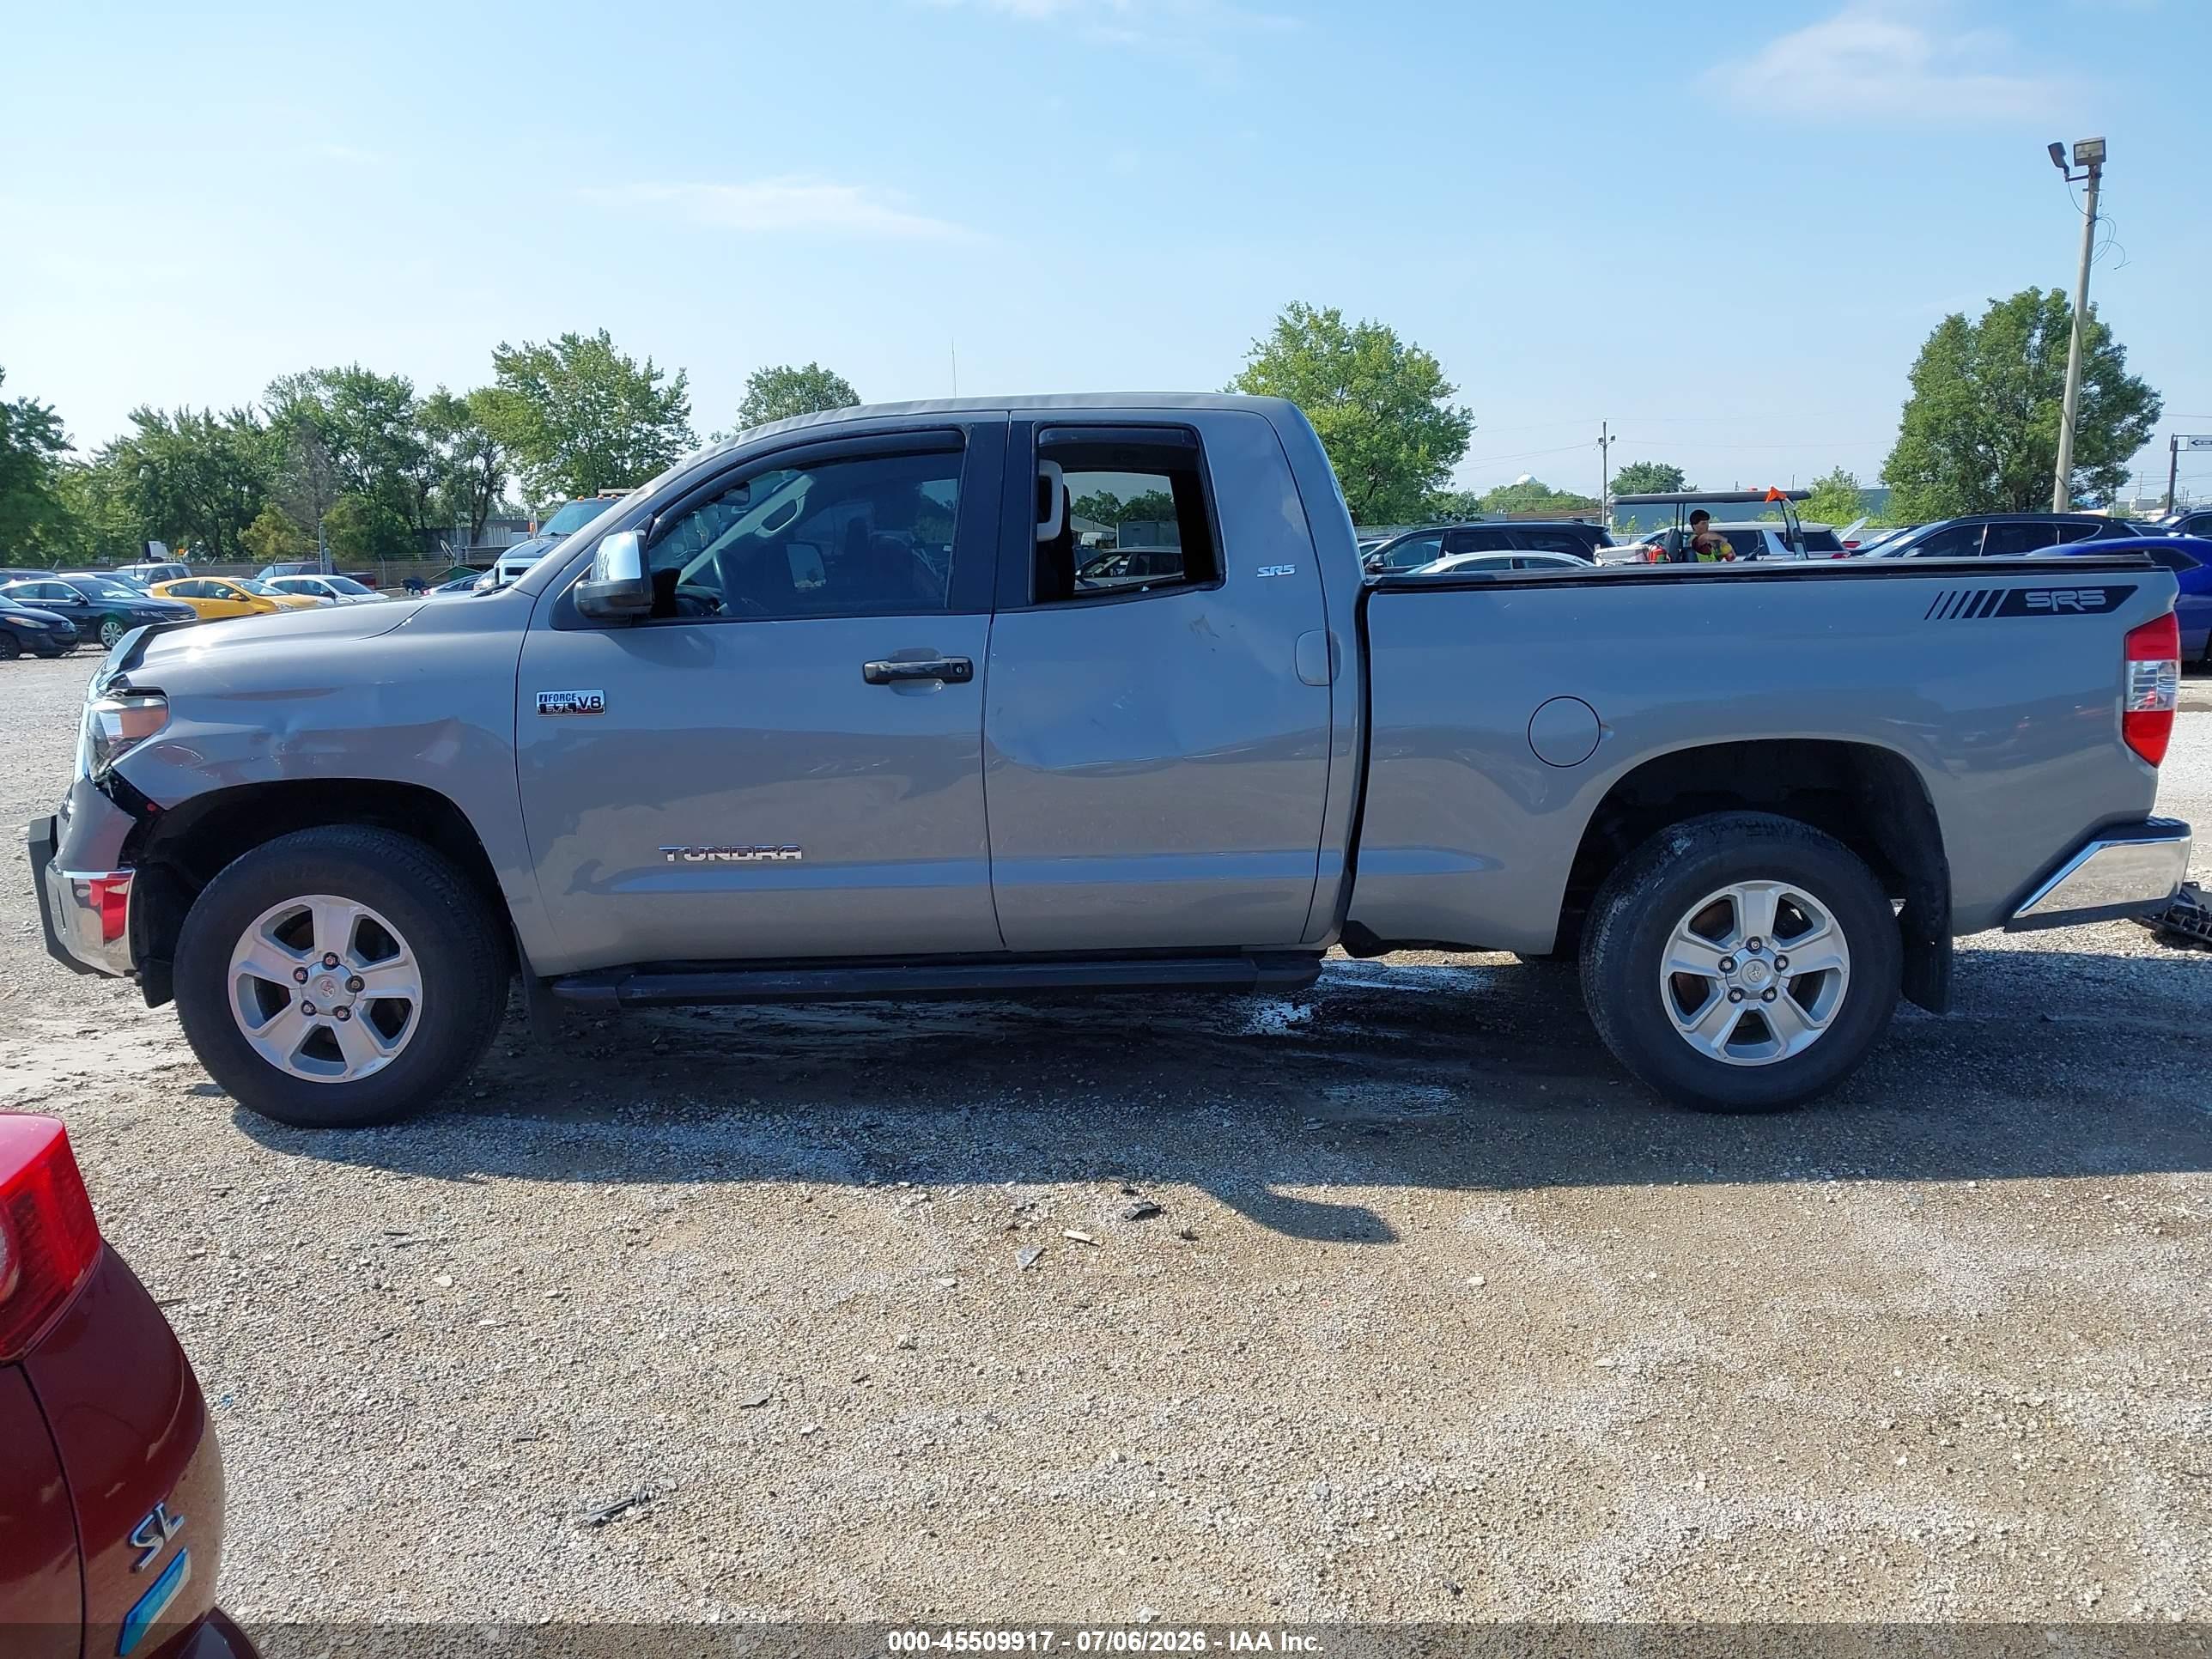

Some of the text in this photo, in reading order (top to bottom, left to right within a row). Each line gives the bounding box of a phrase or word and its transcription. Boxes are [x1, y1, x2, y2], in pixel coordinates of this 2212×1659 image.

[1257, 564, 1295, 577] SR5
[2025, 590, 2106, 611] SR5
[578, 696, 602, 710] V8
[659, 845, 802, 861] TUNDRA
[129, 1503, 185, 1572] SL
